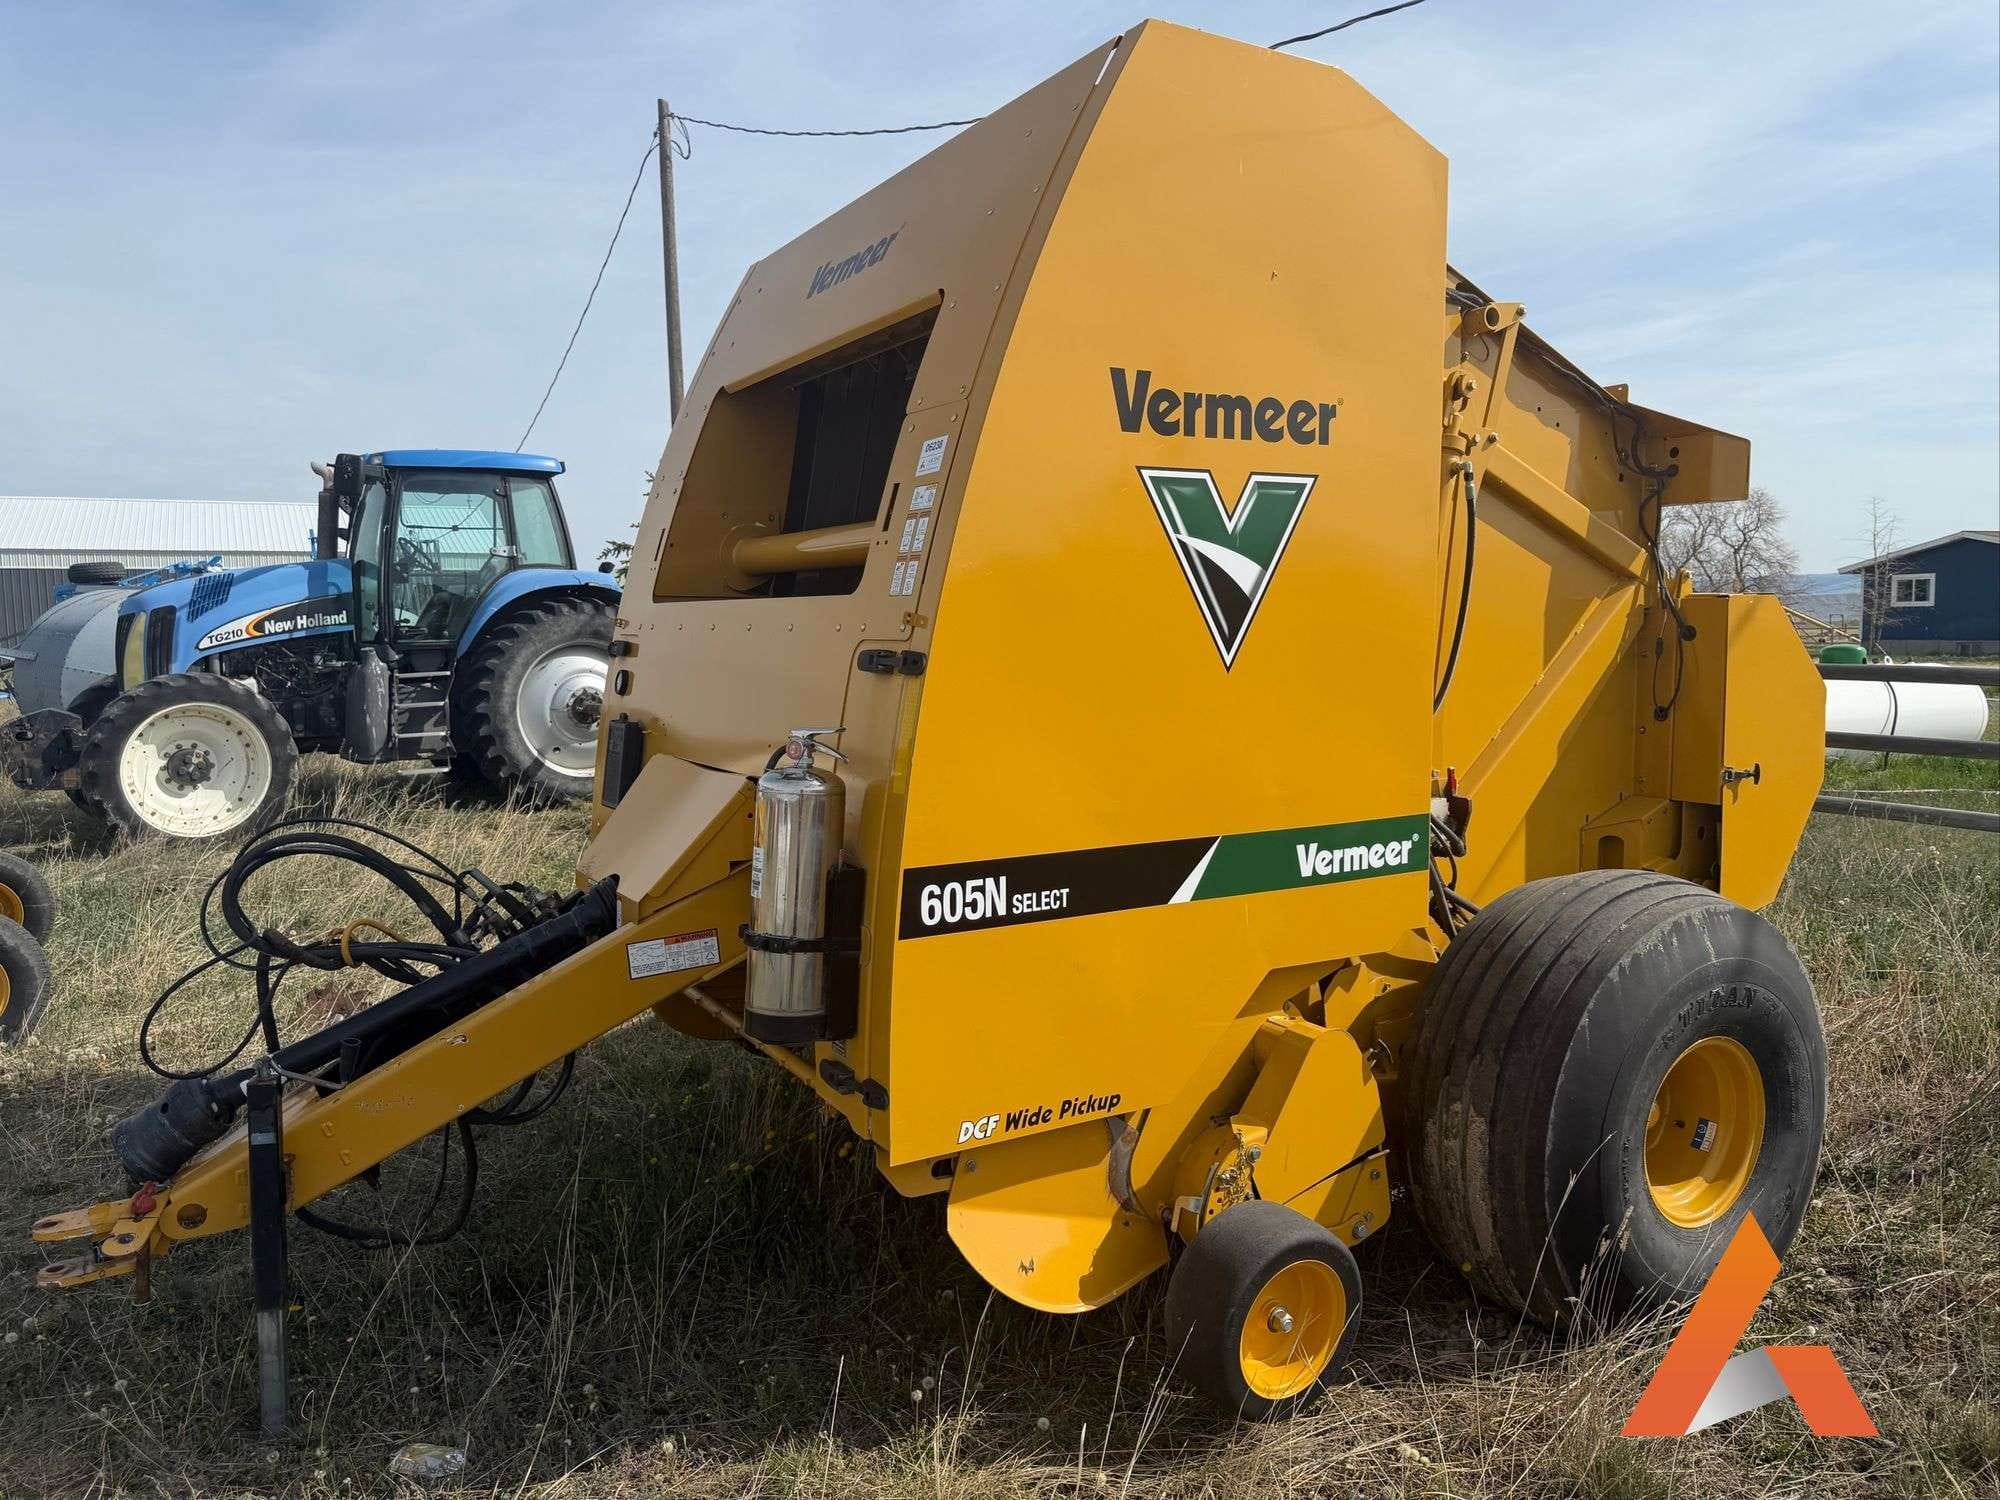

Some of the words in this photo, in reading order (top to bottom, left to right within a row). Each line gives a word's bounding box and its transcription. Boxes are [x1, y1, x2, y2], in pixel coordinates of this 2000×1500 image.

[806, 231, 900, 299] Vermeer
[1109, 367, 1337, 446] Vermeer
[208, 629, 243, 644] TG210
[264, 620, 295, 634] New
[297, 610, 347, 629] Holland
[1296, 839, 1413, 878] Vermeer
[920, 875, 1007, 926] 605N
[1012, 888, 1070, 915] SELECT
[957, 1114, 1000, 1144] DCF
[1004, 1105, 1053, 1133] Wide
[1058, 1093, 1121, 1120] Pickup
